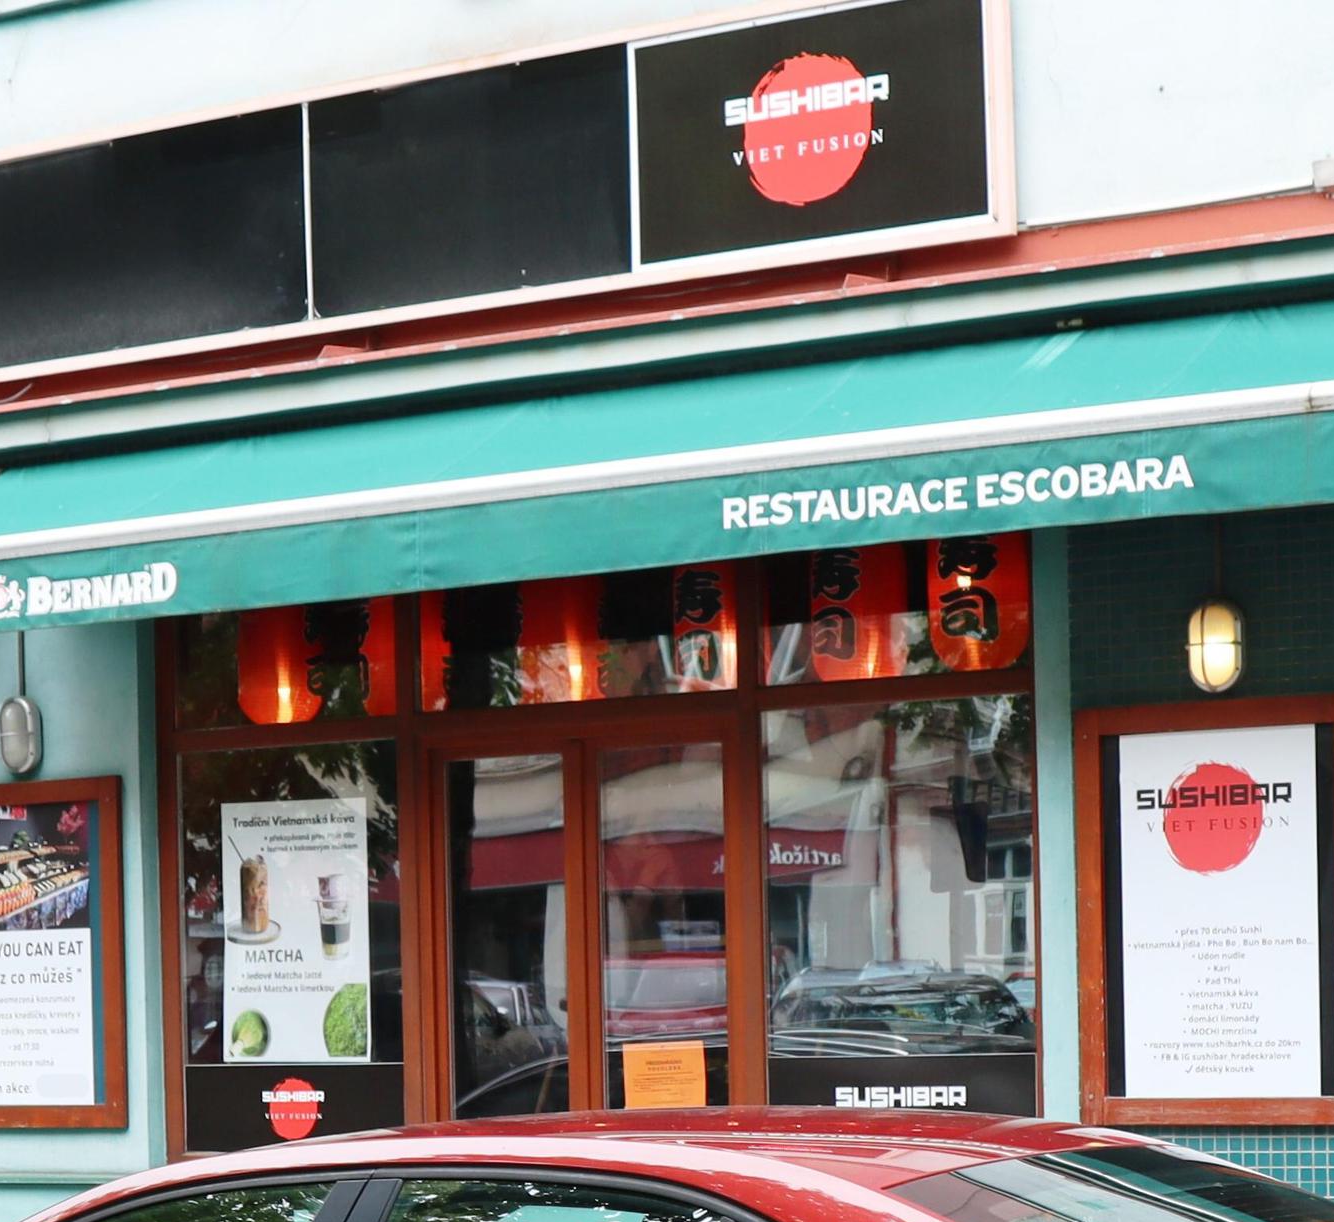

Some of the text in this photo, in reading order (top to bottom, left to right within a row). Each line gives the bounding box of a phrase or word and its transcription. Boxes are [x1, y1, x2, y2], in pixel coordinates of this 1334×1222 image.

[724, 73, 890, 127] SUSHIBAR
[732, 128, 885, 167] VIET FUSION
[722, 456, 1194, 530] RESTAURACE ESCOBARA
[25, 561, 178, 615] BERNARD
[1137, 782, 1292, 810] SUSHIBAR
[233, 816, 270, 829] Tradiční
[272, 815, 328, 827] Vietnamská
[1146, 816, 1290, 833] VIET FUSION
[1200, 927, 1210, 935] 70
[25, 942, 54, 957] CAN
[58, 940, 84, 956] EAT
[1133, 941, 1181, 950] vietnamská
[1207, 939, 1224, 948] Pho
[1242, 938, 1260, 947] Bun
[1261, 938, 1273, 946] Bo
[244, 949, 304, 964] MATCHA
[1198, 951, 1245, 960] Udon nudle
[10, 973, 26, 985] co
[274, 971, 303, 980] Matcha
[1205, 977, 1221, 985] Pad
[264, 984, 293, 993] Matcha
[1188, 989, 1259, 998] vietnamská káva
[1192, 1002, 1253, 1010] matcha YUZU
[1265, 1039, 1276, 1047] do
[1278, 1039, 1301, 1047] 20km
[1225, 1065, 1254, 1073] koutek
[261, 1090, 325, 1103] SUSHIBAR
[835, 1086, 967, 1109] SUSHIBAR
